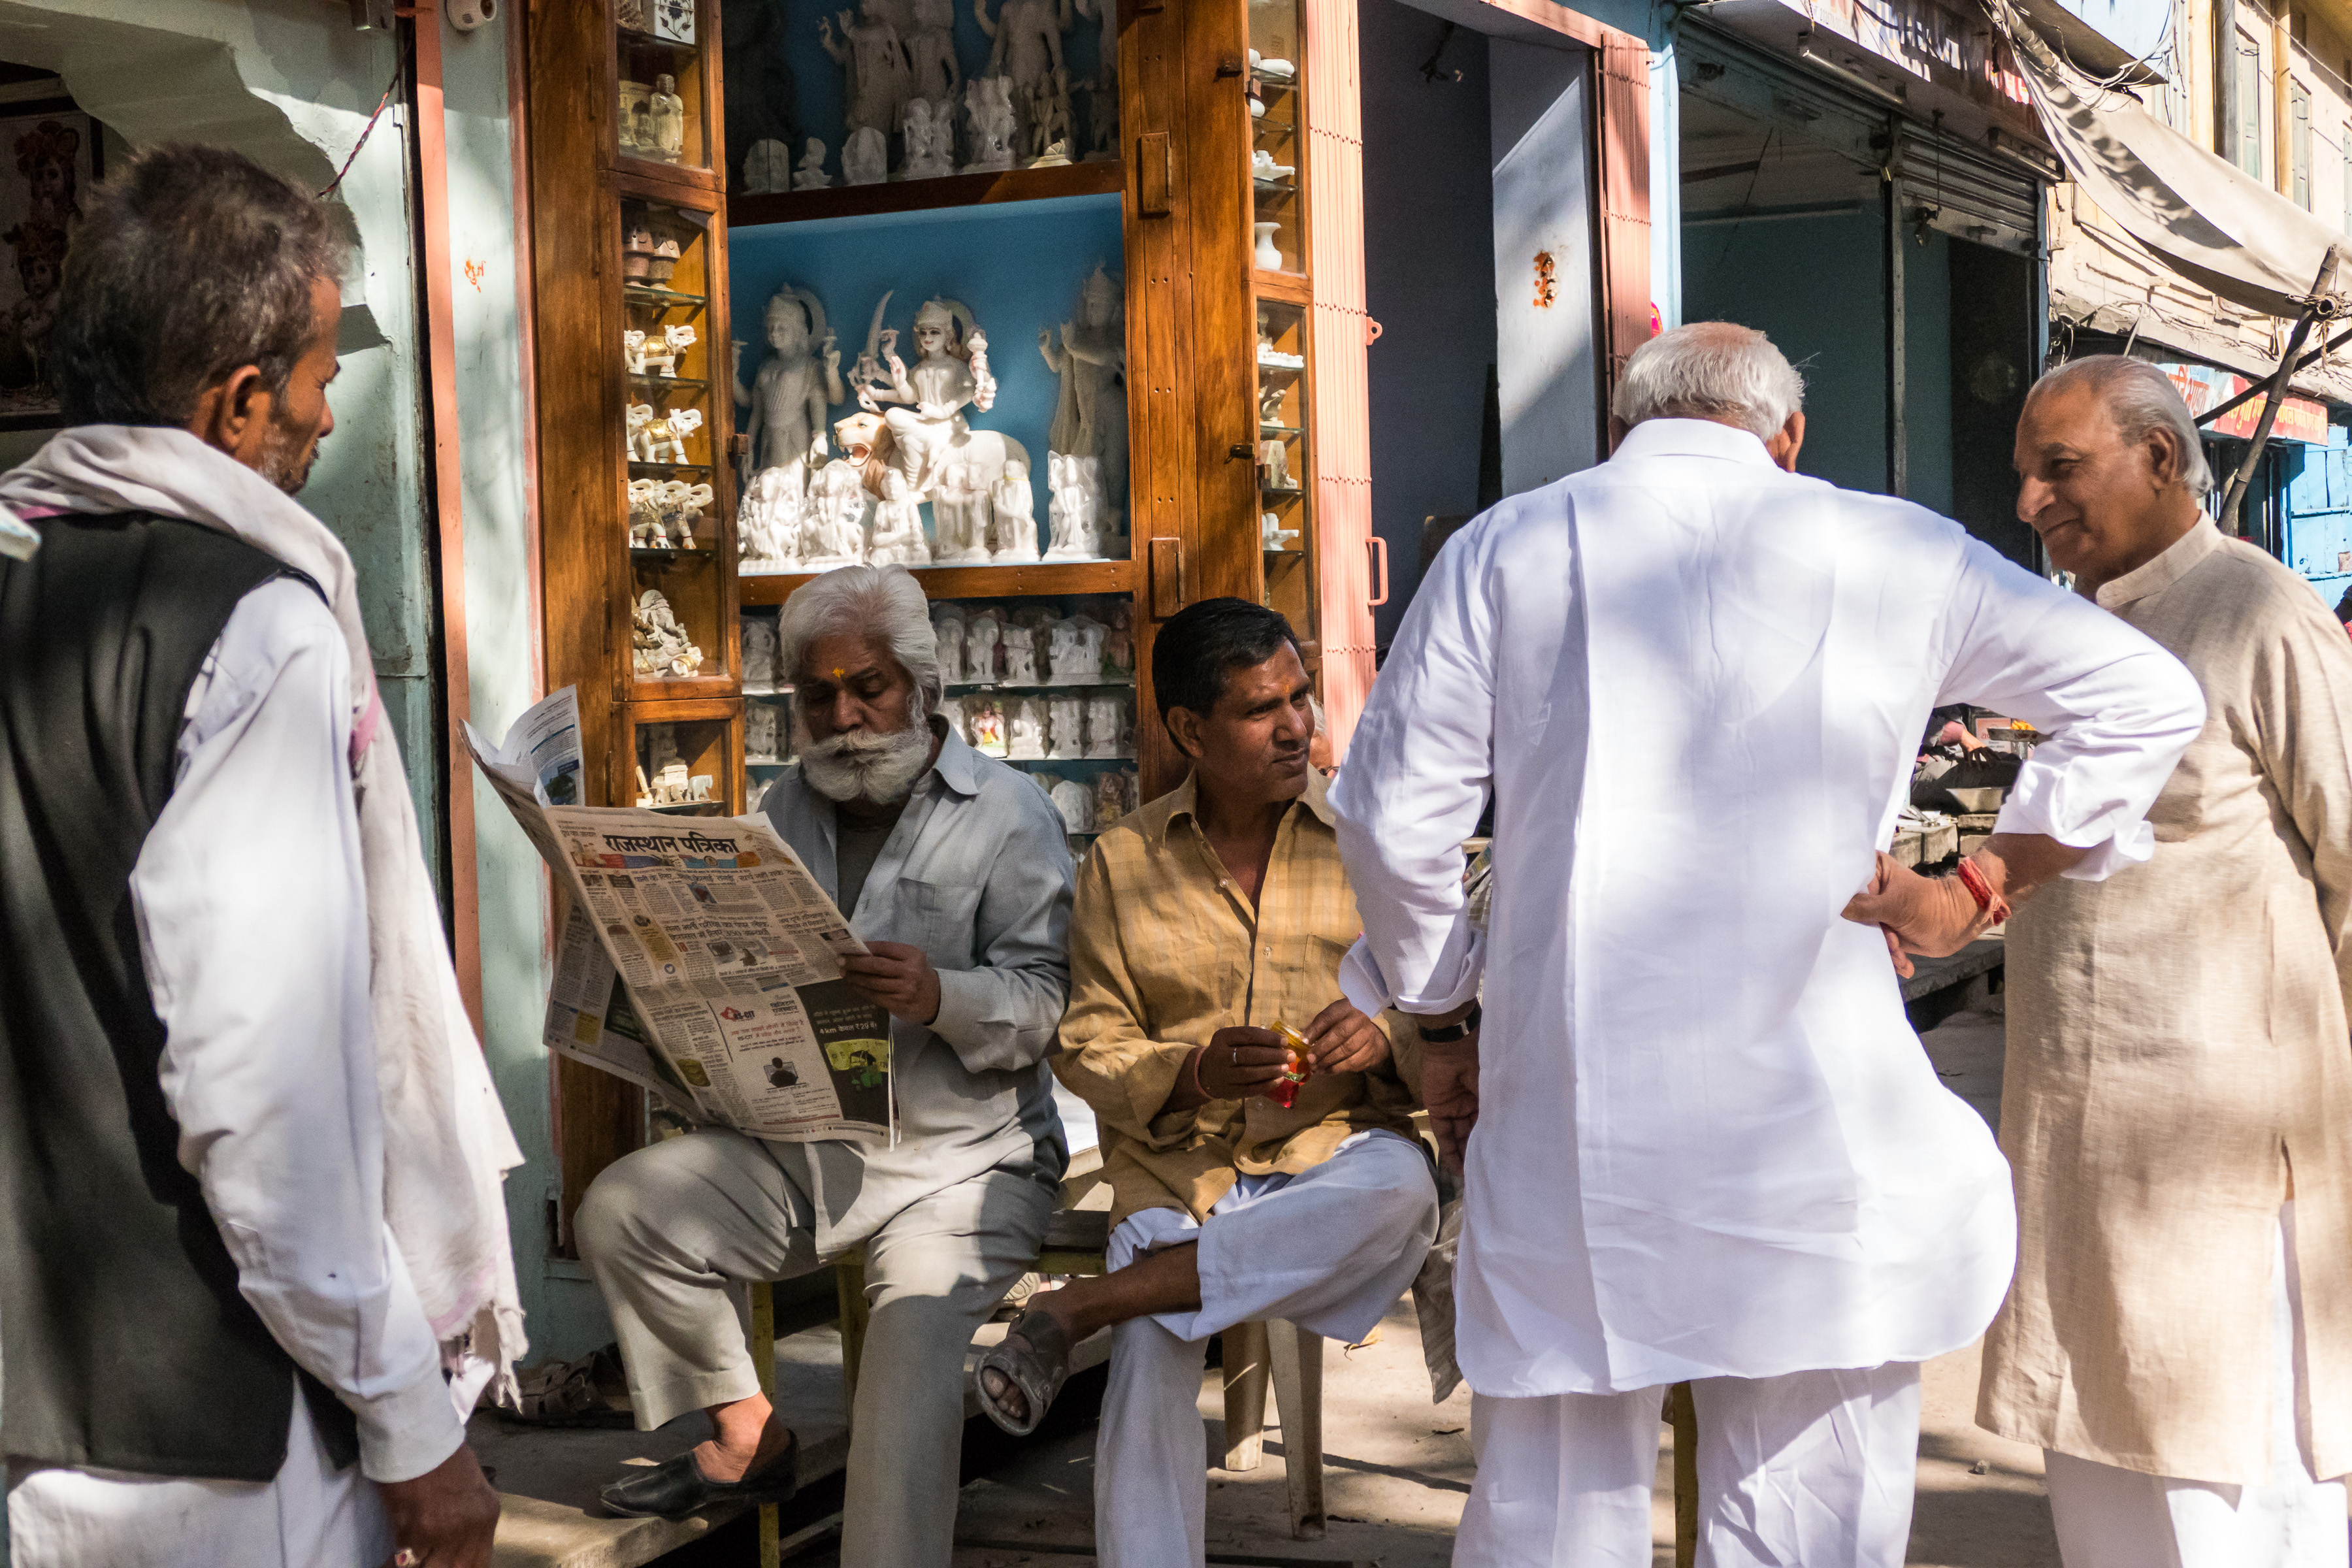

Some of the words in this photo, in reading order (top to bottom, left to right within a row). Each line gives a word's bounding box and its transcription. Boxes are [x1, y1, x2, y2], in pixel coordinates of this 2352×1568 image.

[602, 834, 679, 853] राजस्थान
[678, 831, 740, 854] पत्रिका
[664, 924, 681, 933] सेना
[682, 921, 698, 931] भर्ती
[698, 920, 721, 929] परीक्षा
[668, 932, 697, 941] हिरासत
[706, 928, 723, 938] लिए
[769, 1000, 795, 1008] डिजिटल
